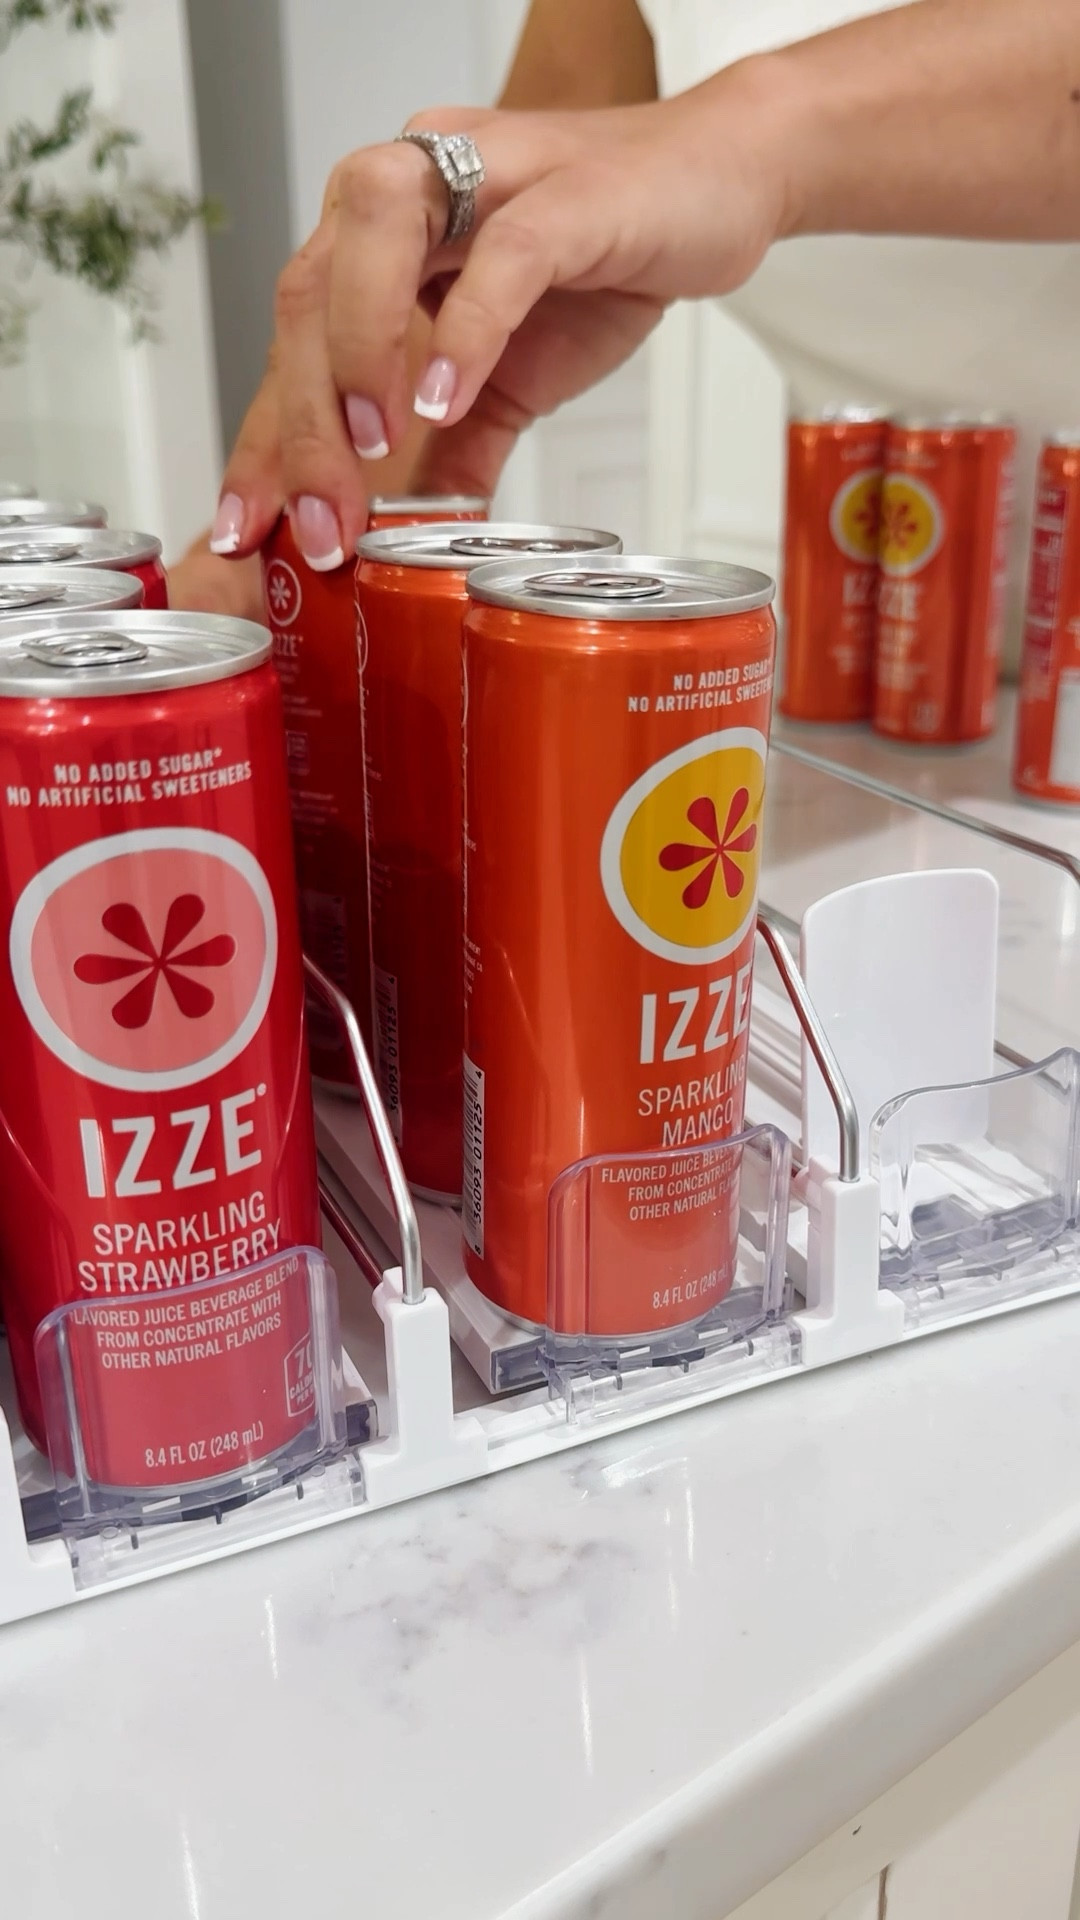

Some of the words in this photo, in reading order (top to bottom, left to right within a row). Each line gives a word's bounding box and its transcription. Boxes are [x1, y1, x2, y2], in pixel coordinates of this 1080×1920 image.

[628, 696, 649, 713] NO
[655, 688, 733, 713] ARTIFICIAL
[673, 674, 693, 691] NO
[698, 667, 740, 689] ADDED
[6, 785, 31, 807] NO
[38, 783, 147, 807] ARTIFICIAL
[152, 760, 253, 800] SWEETENERS
[54, 764, 81, 785] NO
[88, 759, 152, 783] ADDED
[640, 962, 753, 1065] IZZE
[637, 1053, 746, 1118] SPARKLING
[79, 1086, 263, 1198] IZZE
[473, 1100, 483, 1160] 01125
[662, 1097, 734, 1148] MANGO
[473, 1165, 482, 1224] 36093
[602, 1164, 667, 1183] FLAVORED
[670, 1157, 700, 1178] JUICE
[628, 1186, 664, 1202] FROM
[667, 1159, 732, 1197] CONCENTRATE
[92, 1190, 266, 1256] SPARKLING
[629, 1206, 670, 1221] OTHER
[673, 1187, 717, 1215] NATURAL
[78, 1217, 281, 1293] STRAWBERRY
[143, 1304, 185, 1326] JUICE
[190, 1281, 263, 1318] BEVERAGE
[265, 1256, 300, 1290] BLEND
[652, 1289, 670, 1309] 8.4
[672, 1285, 683, 1304] FL
[685, 1279, 698, 1300] OZ
[700, 1270, 717, 1296] (248
[96, 1331, 140, 1348] FROM
[143, 1309, 249, 1347] CONCENTRATE
[251, 1290, 282, 1318] WITH
[102, 1352, 151, 1369] OTHER
[155, 1338, 223, 1367] NATURAL
[226, 1312, 282, 1350] FLAVORS
[145, 1447, 167, 1468] 8.4
[170, 1444, 186, 1465] FL
[189, 1440, 207, 1463] OZ
[210, 1429, 239, 1459] (248
[242, 1420, 264, 1446] mL)
